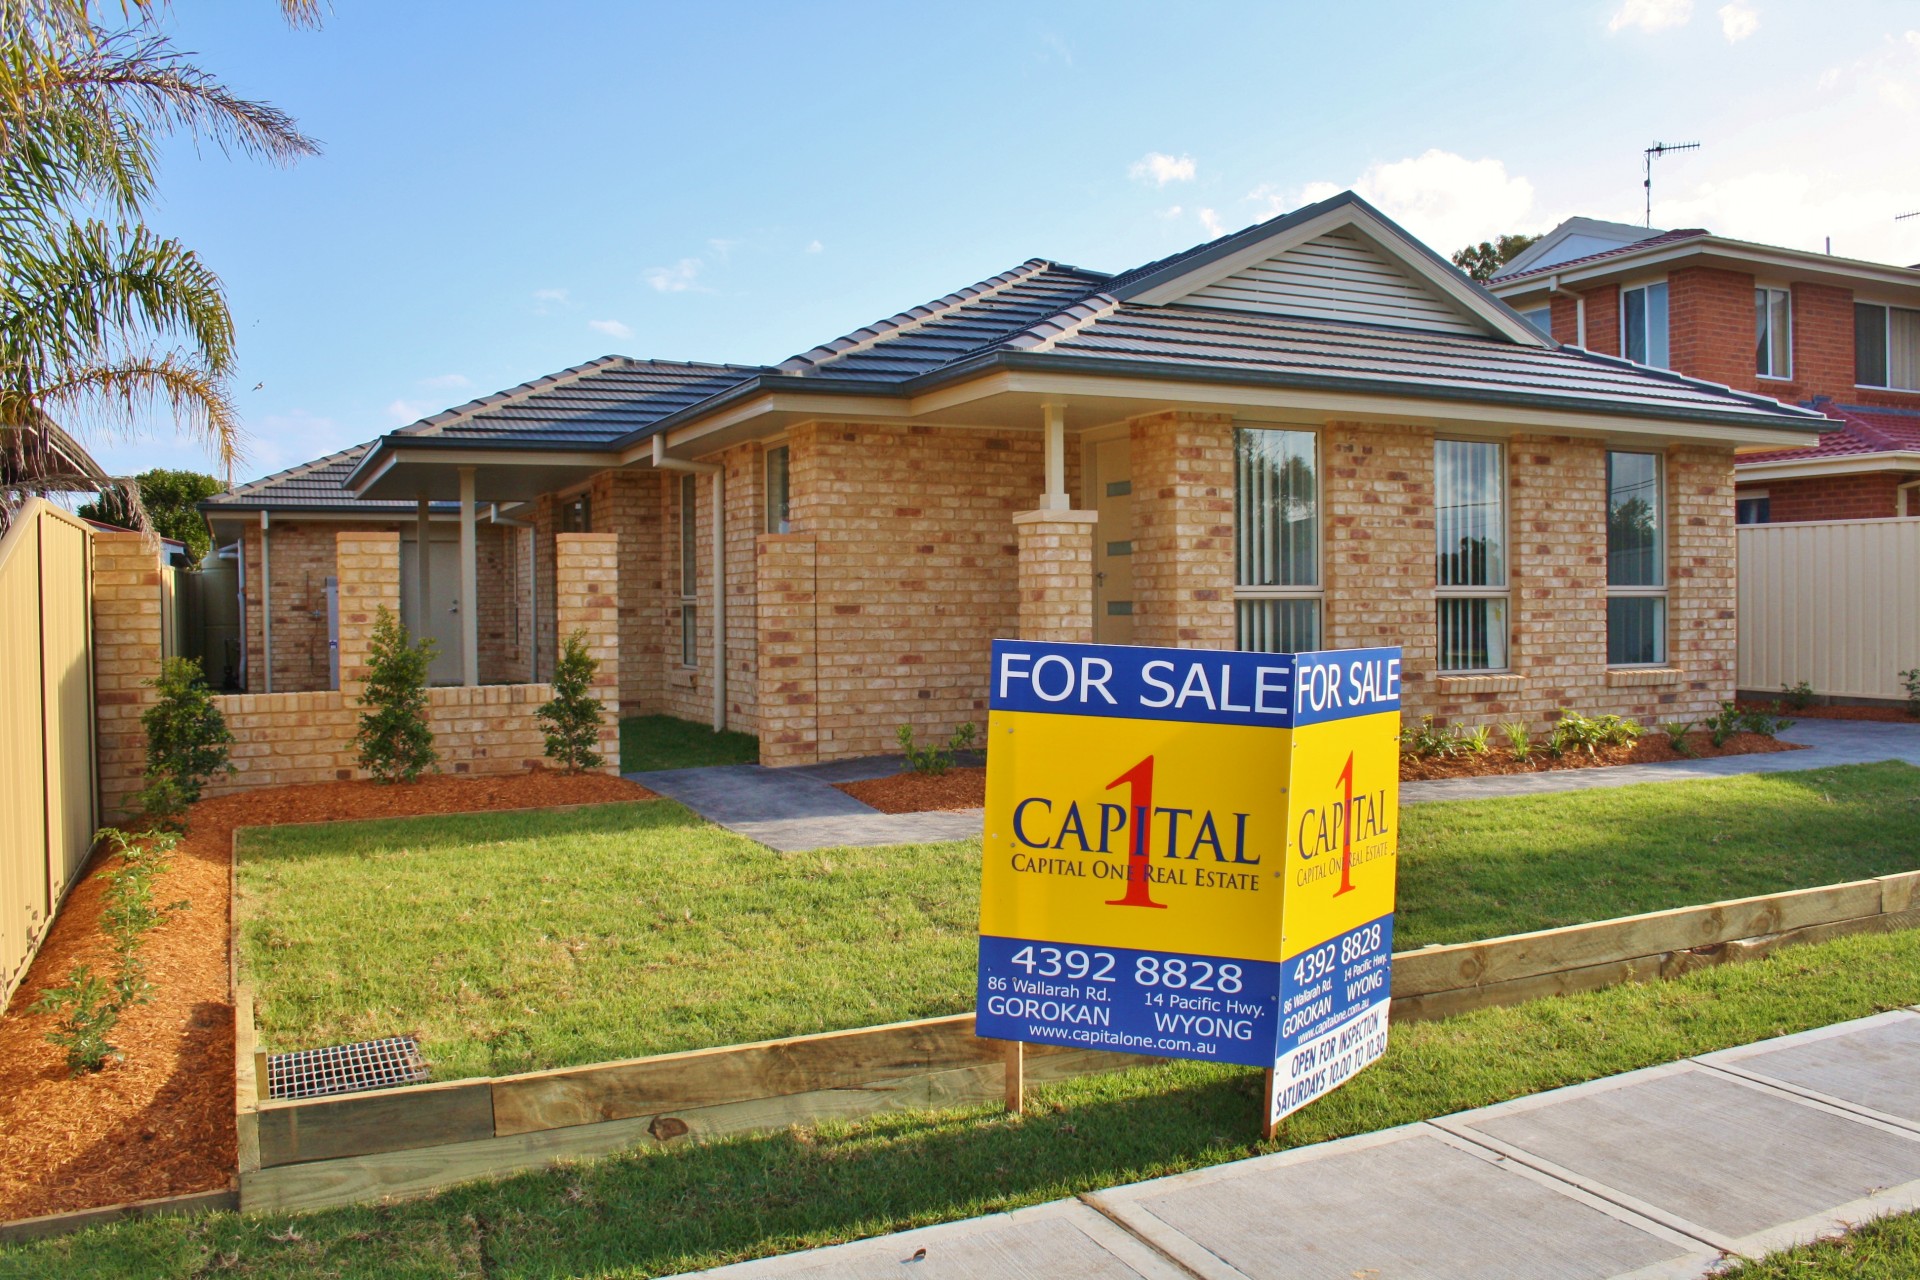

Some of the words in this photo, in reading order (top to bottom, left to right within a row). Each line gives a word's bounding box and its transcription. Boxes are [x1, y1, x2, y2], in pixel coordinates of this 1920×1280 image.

[1000, 653, 1118, 705] FOR
[1140, 660, 1290, 715] SALE
[1298, 664, 1342, 713] FOR
[1349, 659, 1399, 706] SALE
[1012, 797, 1261, 865] CAPITAL
[1105, 754, 1168, 909] 1
[1298, 789, 1388, 860] CAPITAL
[1011, 853, 1086, 877] CAPITAL
[1092, 860, 1134, 881] ONE
[1143, 864, 1188, 885] REAL
[1195, 868, 1260, 891] ESTATE
[1297, 864, 1326, 887] CAPITAL
[1365, 841, 1388, 862] ESTATE
[1011, 946, 1116, 982] 4392
[1134, 956, 1243, 994] 8828
[1293, 943, 1336, 986] 4392
[1341, 923, 1381, 964] 8828
[1344, 967, 1352, 982] 14
[1353, 958, 1372, 977] Pacific
[1372, 953, 1387, 968] Hwy.
[988, 976, 1007, 991] 86
[1013, 979, 1080, 999] Wallarah
[1086, 988, 1111, 1001] Rd.
[1144, 992, 1164, 1007] 14
[1169, 994, 1221, 1013] Pacific
[1226, 1000, 1265, 1017] Hwy.
[1283, 998, 1293, 1015] 86
[1293, 983, 1321, 1009] Wallarah
[1321, 977, 1333, 993] Rd.
[1346, 969, 1383, 1002] WYONG
[987, 995, 1110, 1026] GOROKAN
[1154, 1012, 1253, 1041] WYONG
[1282, 994, 1332, 1039] GOROKAN
[1297, 998, 1370, 1045] www.capitalone.com.au
[1029, 1025, 1217, 1054] www.capitalone.com.au
[1291, 1046, 1317, 1078] OPEN
[1319, 1036, 1336, 1064] FOR
[1339, 1010, 1379, 1054] INSPECTION
[1276, 1068, 1326, 1117] SATURDAYS
[1329, 1054, 1352, 1086] 10.00
[1355, 1045, 1364, 1070] TO
[1366, 1032, 1385, 1061] 10.30
